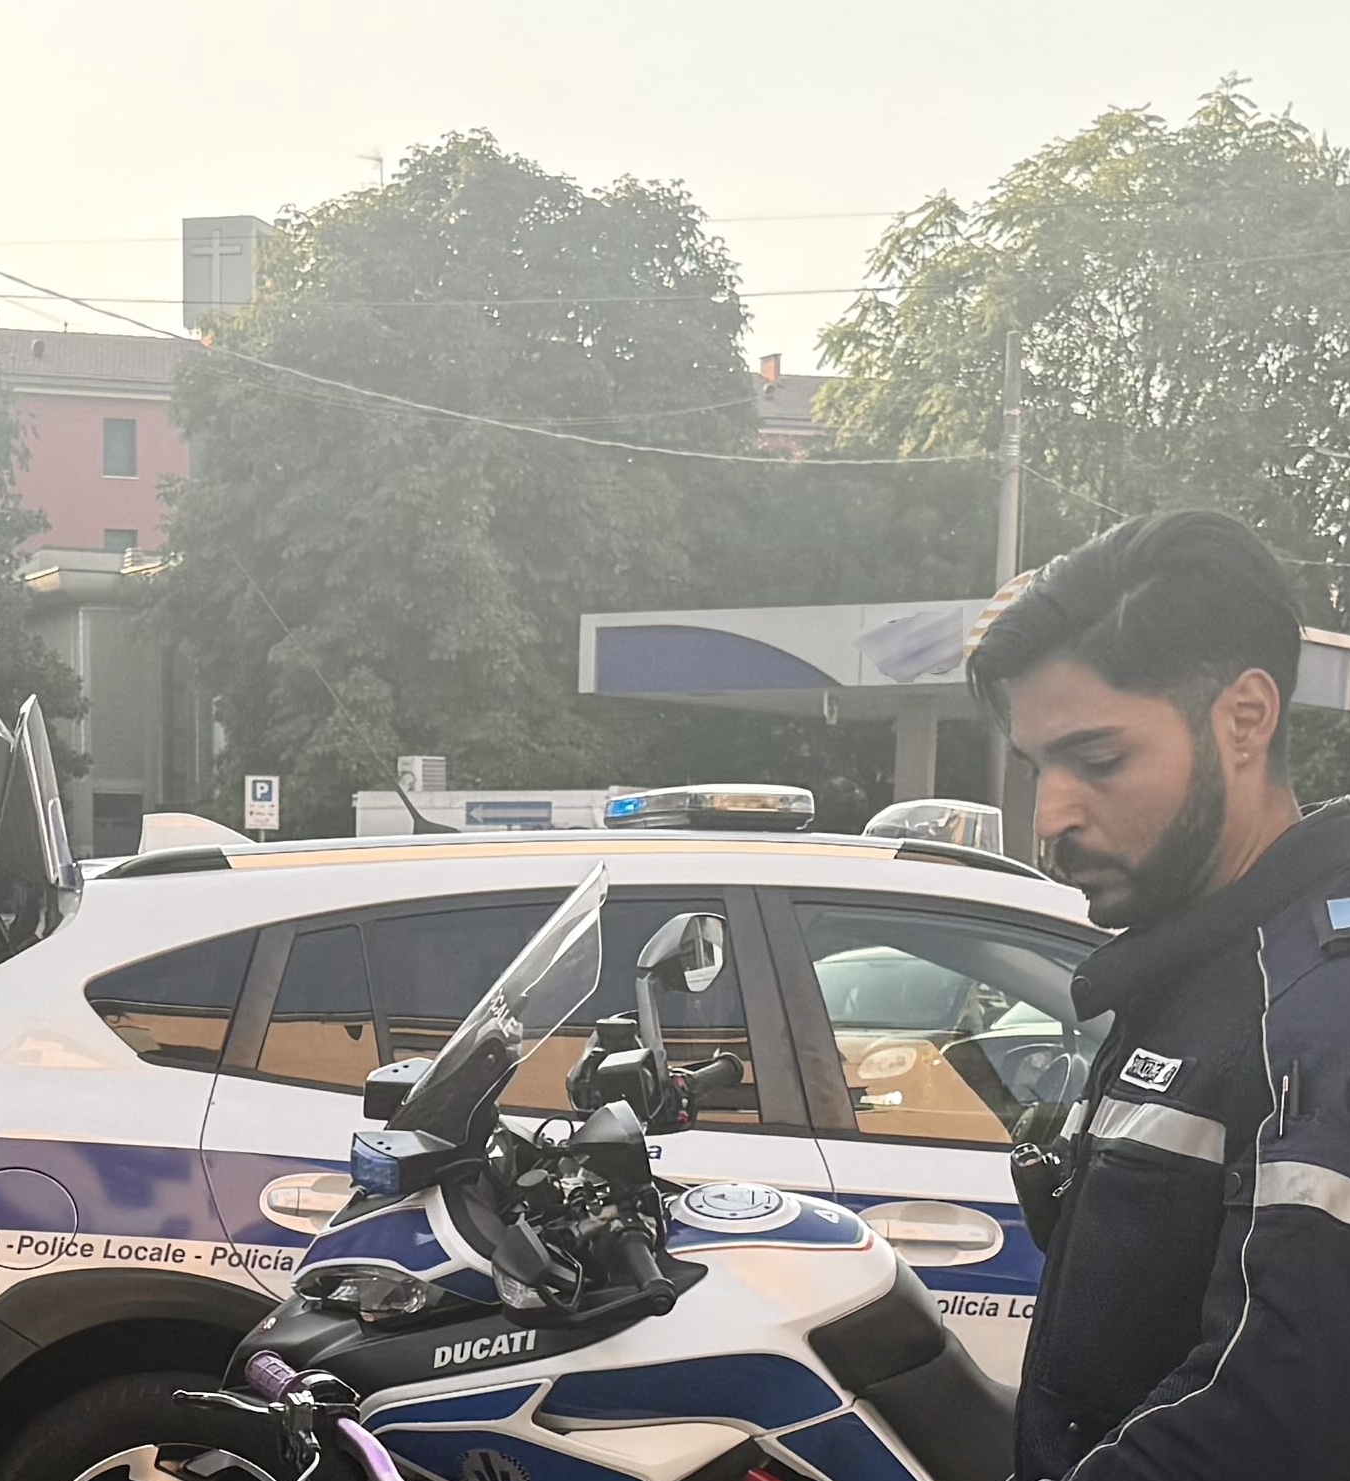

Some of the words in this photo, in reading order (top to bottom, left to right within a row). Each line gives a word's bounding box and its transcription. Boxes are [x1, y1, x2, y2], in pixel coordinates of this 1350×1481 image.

[103, 1239, 186, 1263] Locale
[211, 1246, 294, 1271] Policía
[937, 1295, 999, 1317] olicía
[433, 1329, 537, 1369] DUCATI
